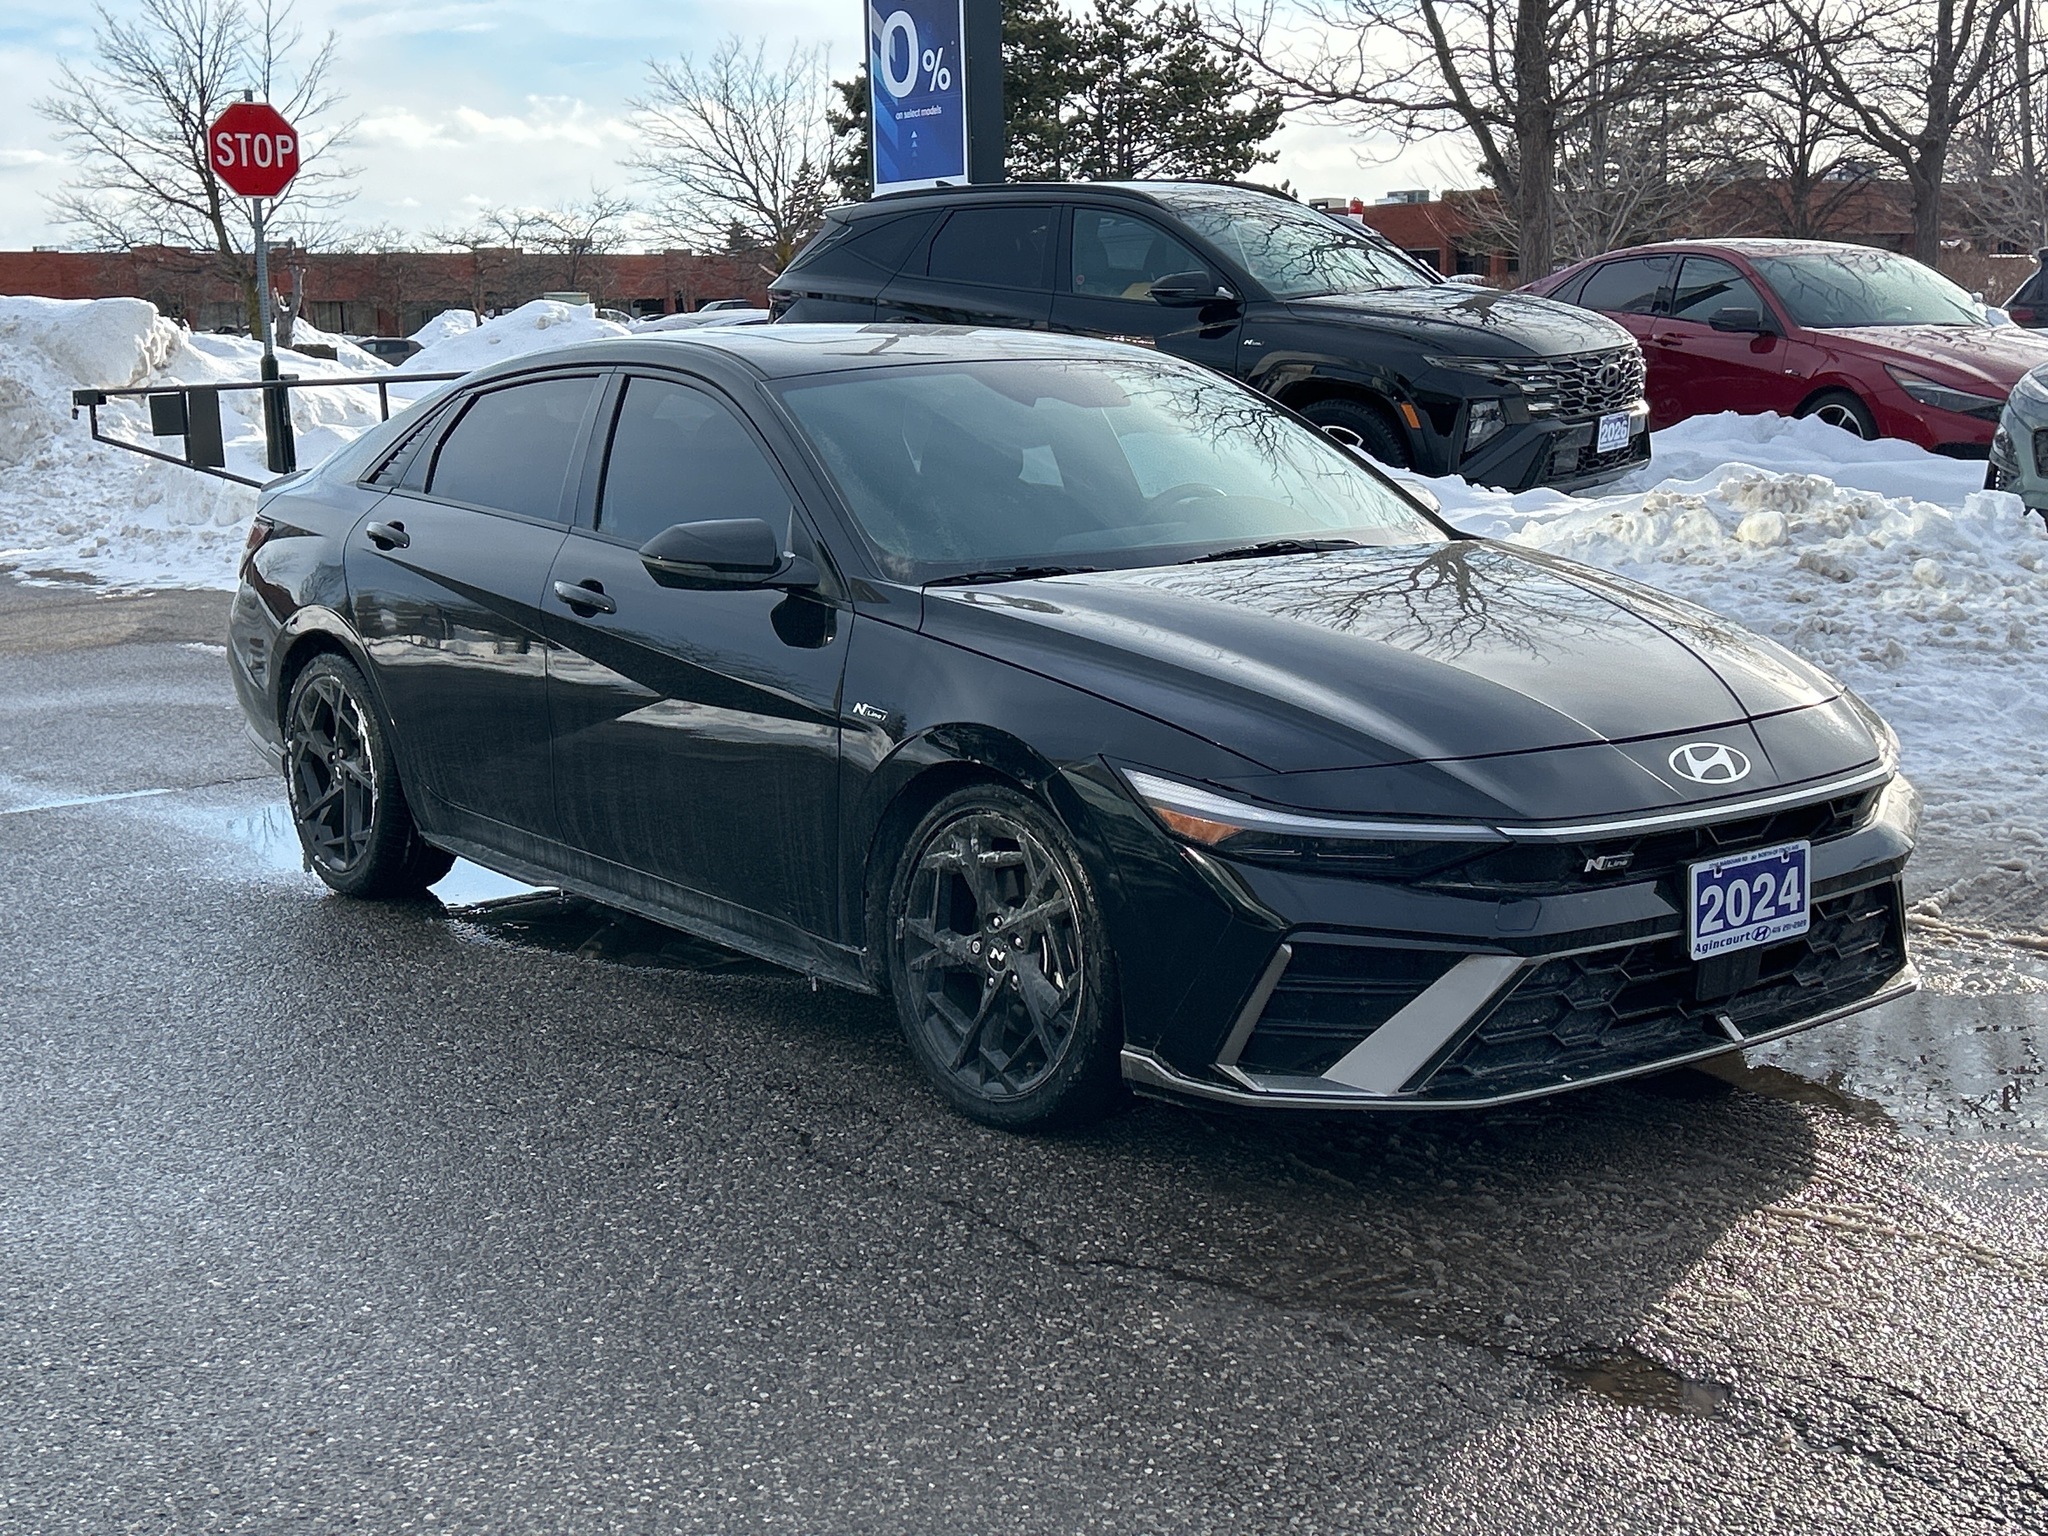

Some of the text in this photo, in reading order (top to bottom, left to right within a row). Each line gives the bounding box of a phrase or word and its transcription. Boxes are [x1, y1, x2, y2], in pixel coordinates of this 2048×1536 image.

[881, 10, 951, 98] 0%
[895, 105, 942, 120] on select models
[216, 132, 294, 168] STOP
[1600, 420, 1628, 443] 2026
[1700, 866, 1801, 935] 2024
[1694, 932, 1750, 954] Agincourt
